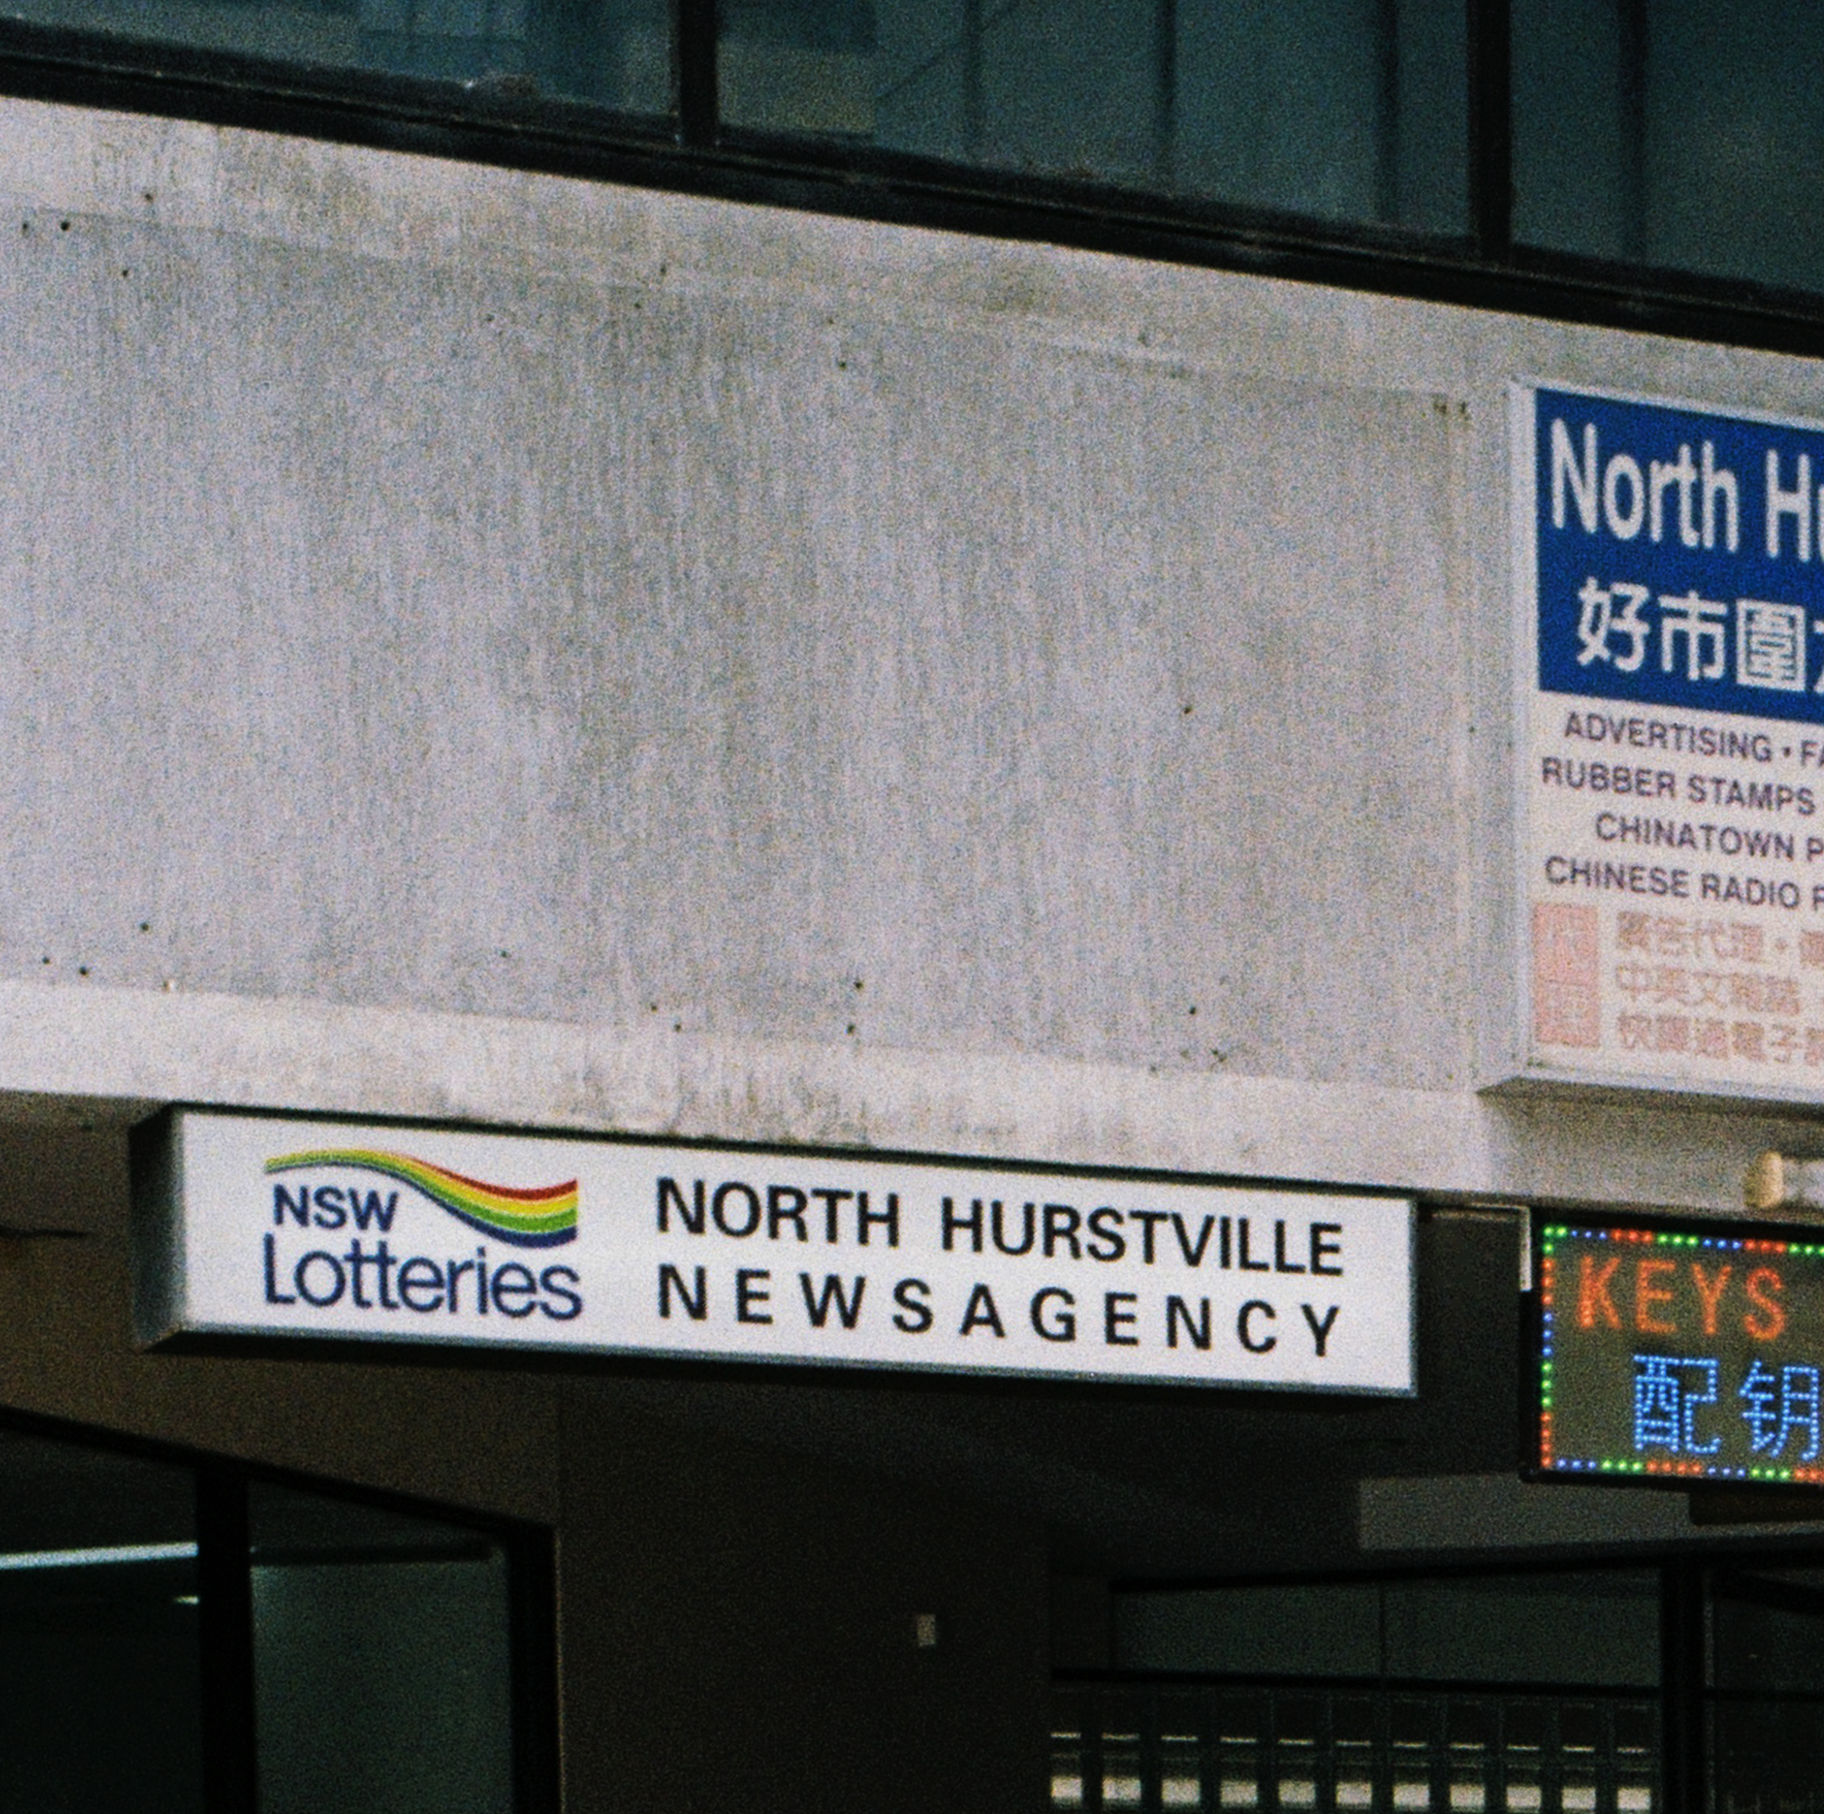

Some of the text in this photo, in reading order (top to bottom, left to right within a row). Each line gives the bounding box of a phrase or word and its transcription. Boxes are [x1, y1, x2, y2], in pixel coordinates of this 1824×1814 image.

[1550, 417, 1739, 554] North
[1563, 710, 1774, 765] ADVERTISING
[1542, 759, 1680, 802] RUBBER
[1687, 775, 1817, 819] STAMPS
[1594, 811, 1796, 867] CHINATOWN
[1543, 855, 1690, 901] CHINESE
[1699, 872, 1802, 915] RADIO
[271, 1177, 1345, 1278] NSW NORTH HURSTVILLE
[263, 1231, 1341, 1360] Lotteries NEWSAGENCY
[1577, 1254, 1787, 1343] KEYS
